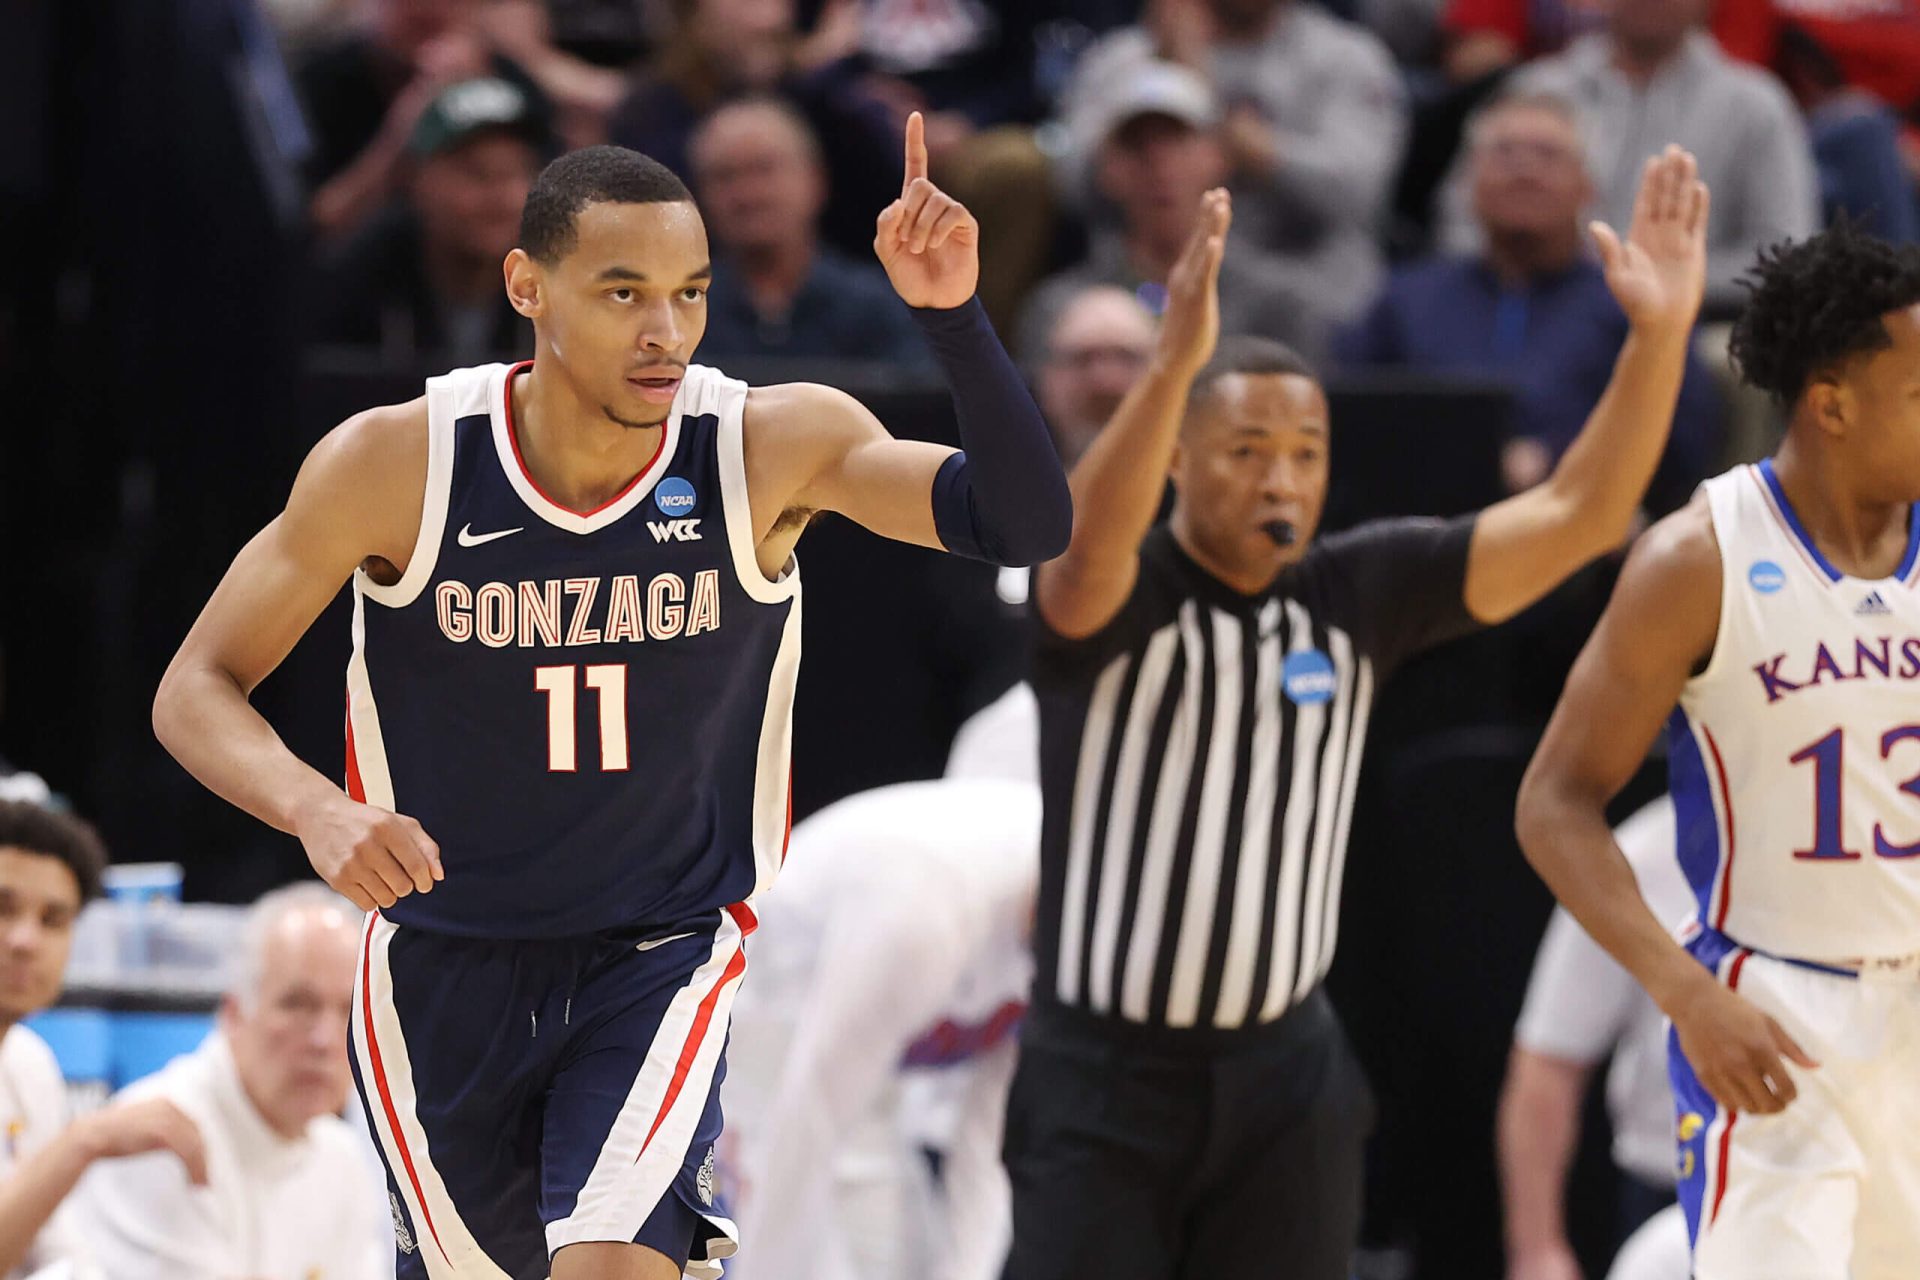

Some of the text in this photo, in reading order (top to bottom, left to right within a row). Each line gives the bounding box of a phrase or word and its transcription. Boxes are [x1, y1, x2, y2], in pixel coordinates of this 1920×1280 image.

[660, 495, 694, 507] NCAA
[646, 518, 703, 544] WCC
[435, 569, 721, 648] GONZAGA
[533, 663, 630, 773] 11
